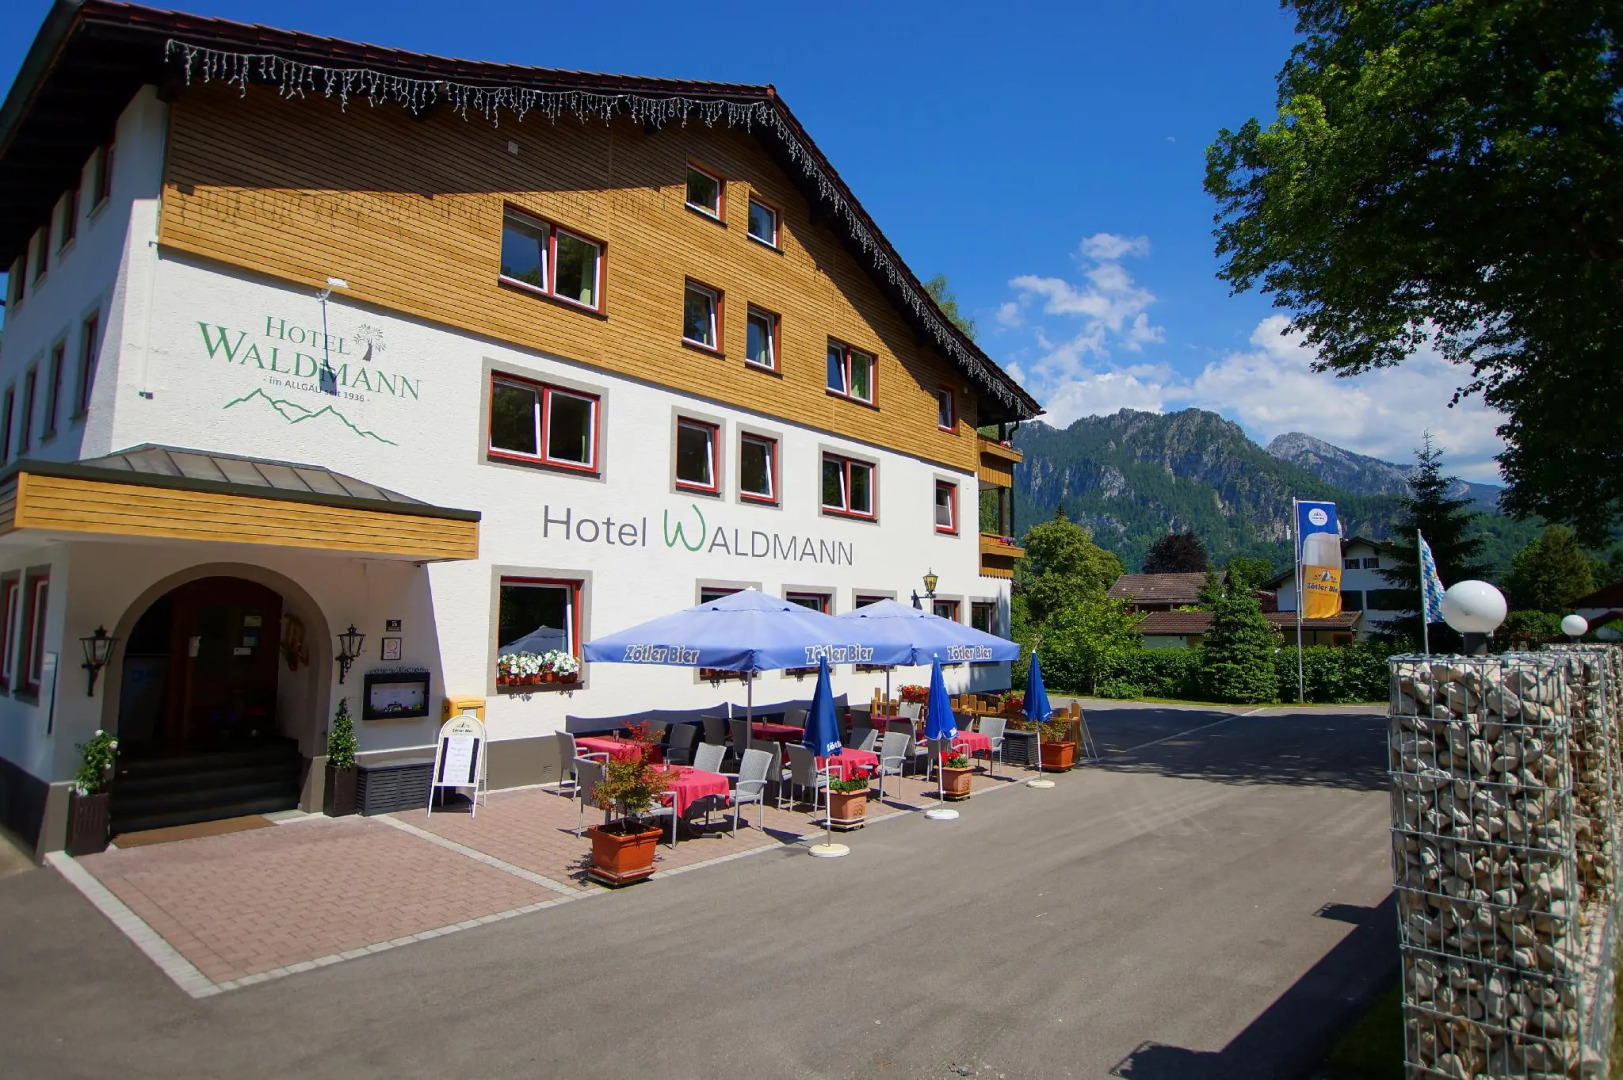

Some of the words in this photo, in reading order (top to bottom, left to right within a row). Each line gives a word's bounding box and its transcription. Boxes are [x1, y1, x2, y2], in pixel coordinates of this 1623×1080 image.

[265, 315, 350, 355] HOTEL
[196, 320, 422, 400] WALDMANN
[269, 376, 282, 386] im
[284, 380, 322, 394] ALLGÄU
[324, 389, 341, 398] seit
[344, 391, 365, 402] 1936
[542, 504, 647, 547] Hotel
[663, 503, 854, 566] WALDMANN
[623, 644, 668, 663] Zötler
[668, 645, 701, 665] Bier
[805, 643, 847, 665] Zötler
[847, 643, 874, 662] Bier
[946, 644, 974, 661] Zötler
[974, 644, 993, 660] Bier
